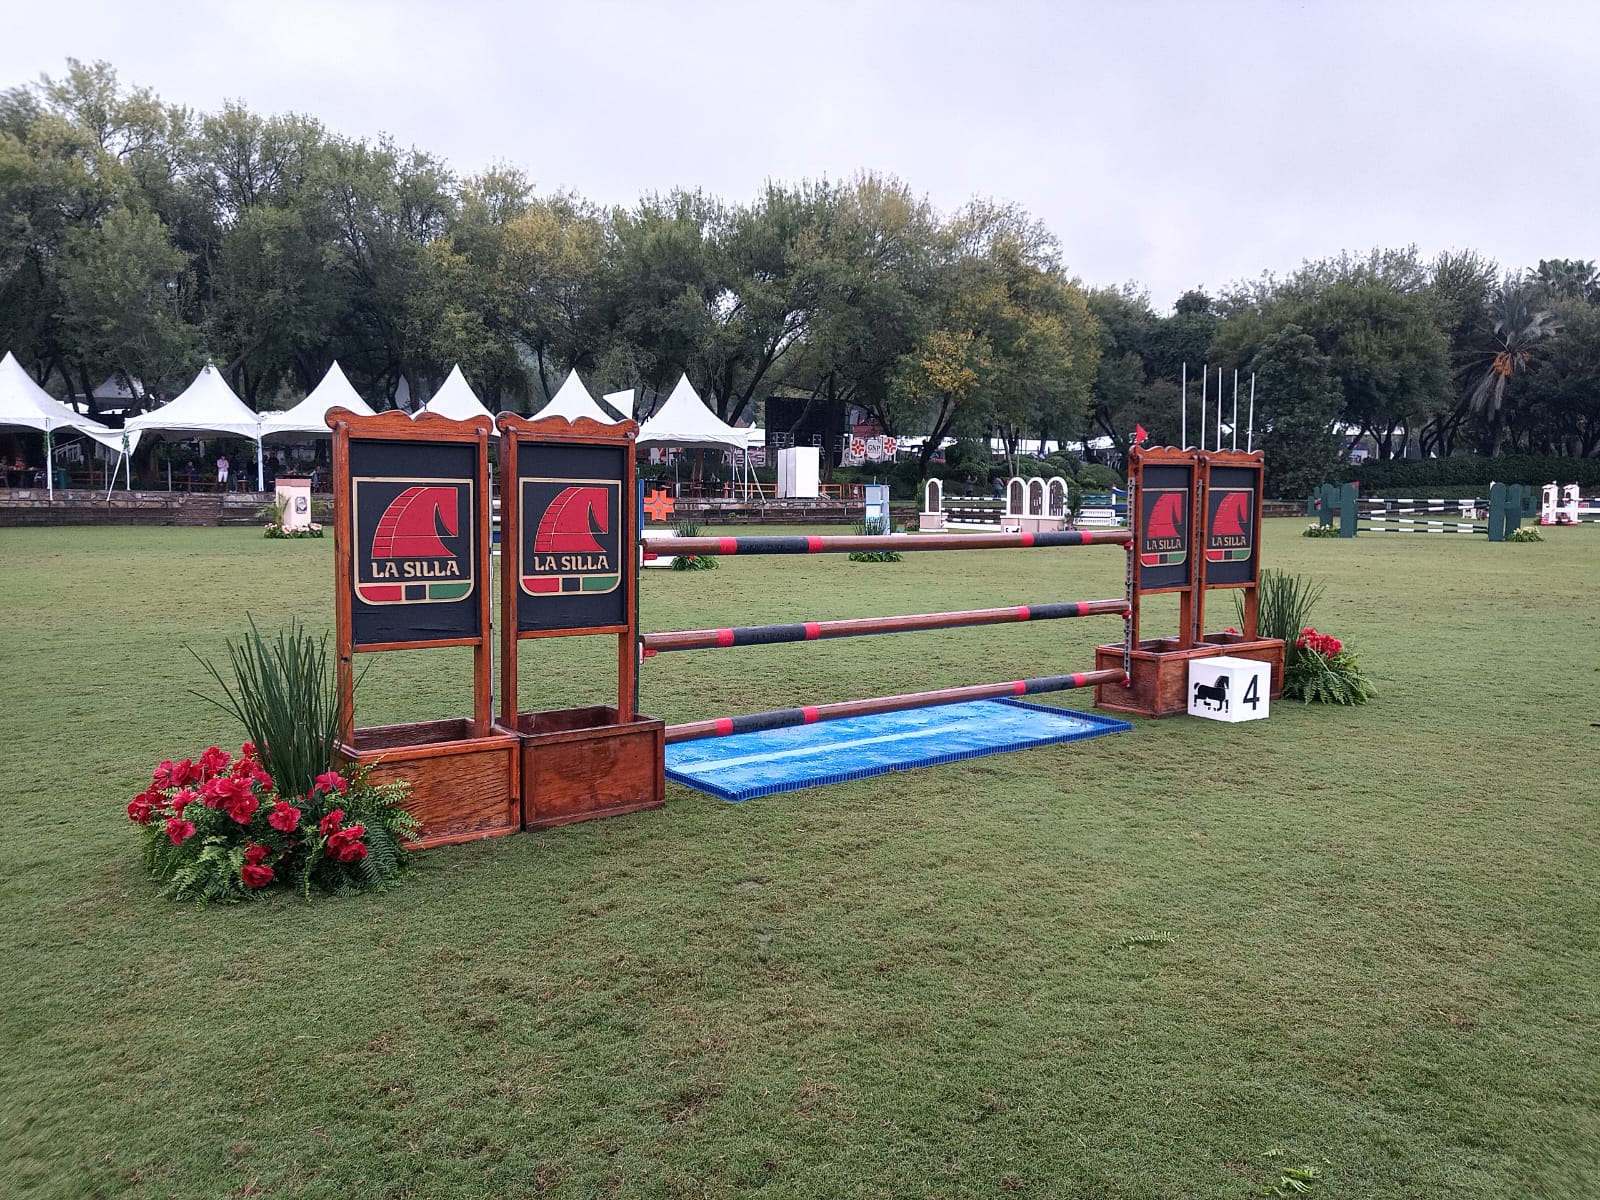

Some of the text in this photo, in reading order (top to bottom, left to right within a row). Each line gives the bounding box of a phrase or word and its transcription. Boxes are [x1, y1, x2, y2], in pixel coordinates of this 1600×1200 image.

[1146, 538, 1182, 551] LA SILLA
[1211, 536, 1246, 547] LA SILLA
[371, 560, 460, 579] LA SILLA
[534, 555, 609, 572] LA SILLA
[1242, 674, 1260, 711] 4
